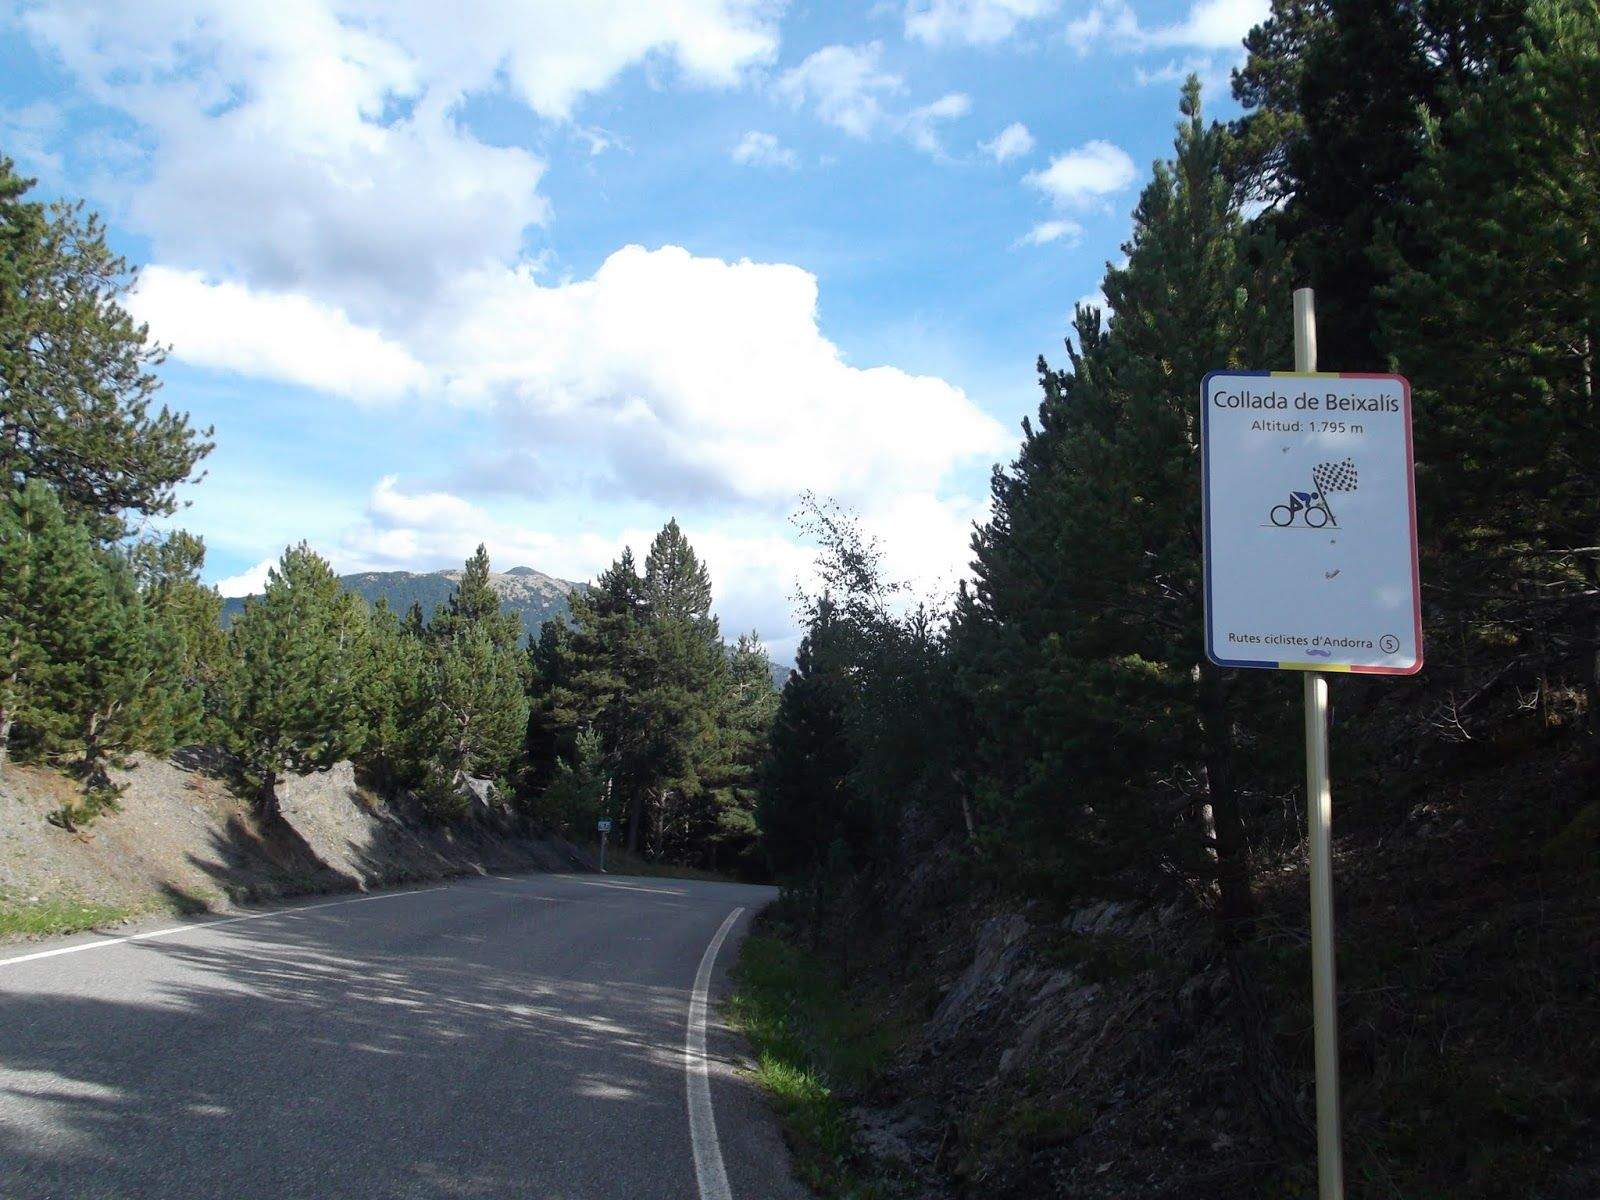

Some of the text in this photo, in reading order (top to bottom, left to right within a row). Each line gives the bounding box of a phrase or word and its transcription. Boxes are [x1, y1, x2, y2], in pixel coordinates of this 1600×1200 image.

[1213, 391, 1400, 412] Collada de Beixalís
[1251, 420, 1364, 434] Altitud: 1.795 m
[1228, 633, 1261, 644] Rutes
[1264, 634, 1309, 646] ciclistes
[1312, 635, 1373, 649] d'Andorra
